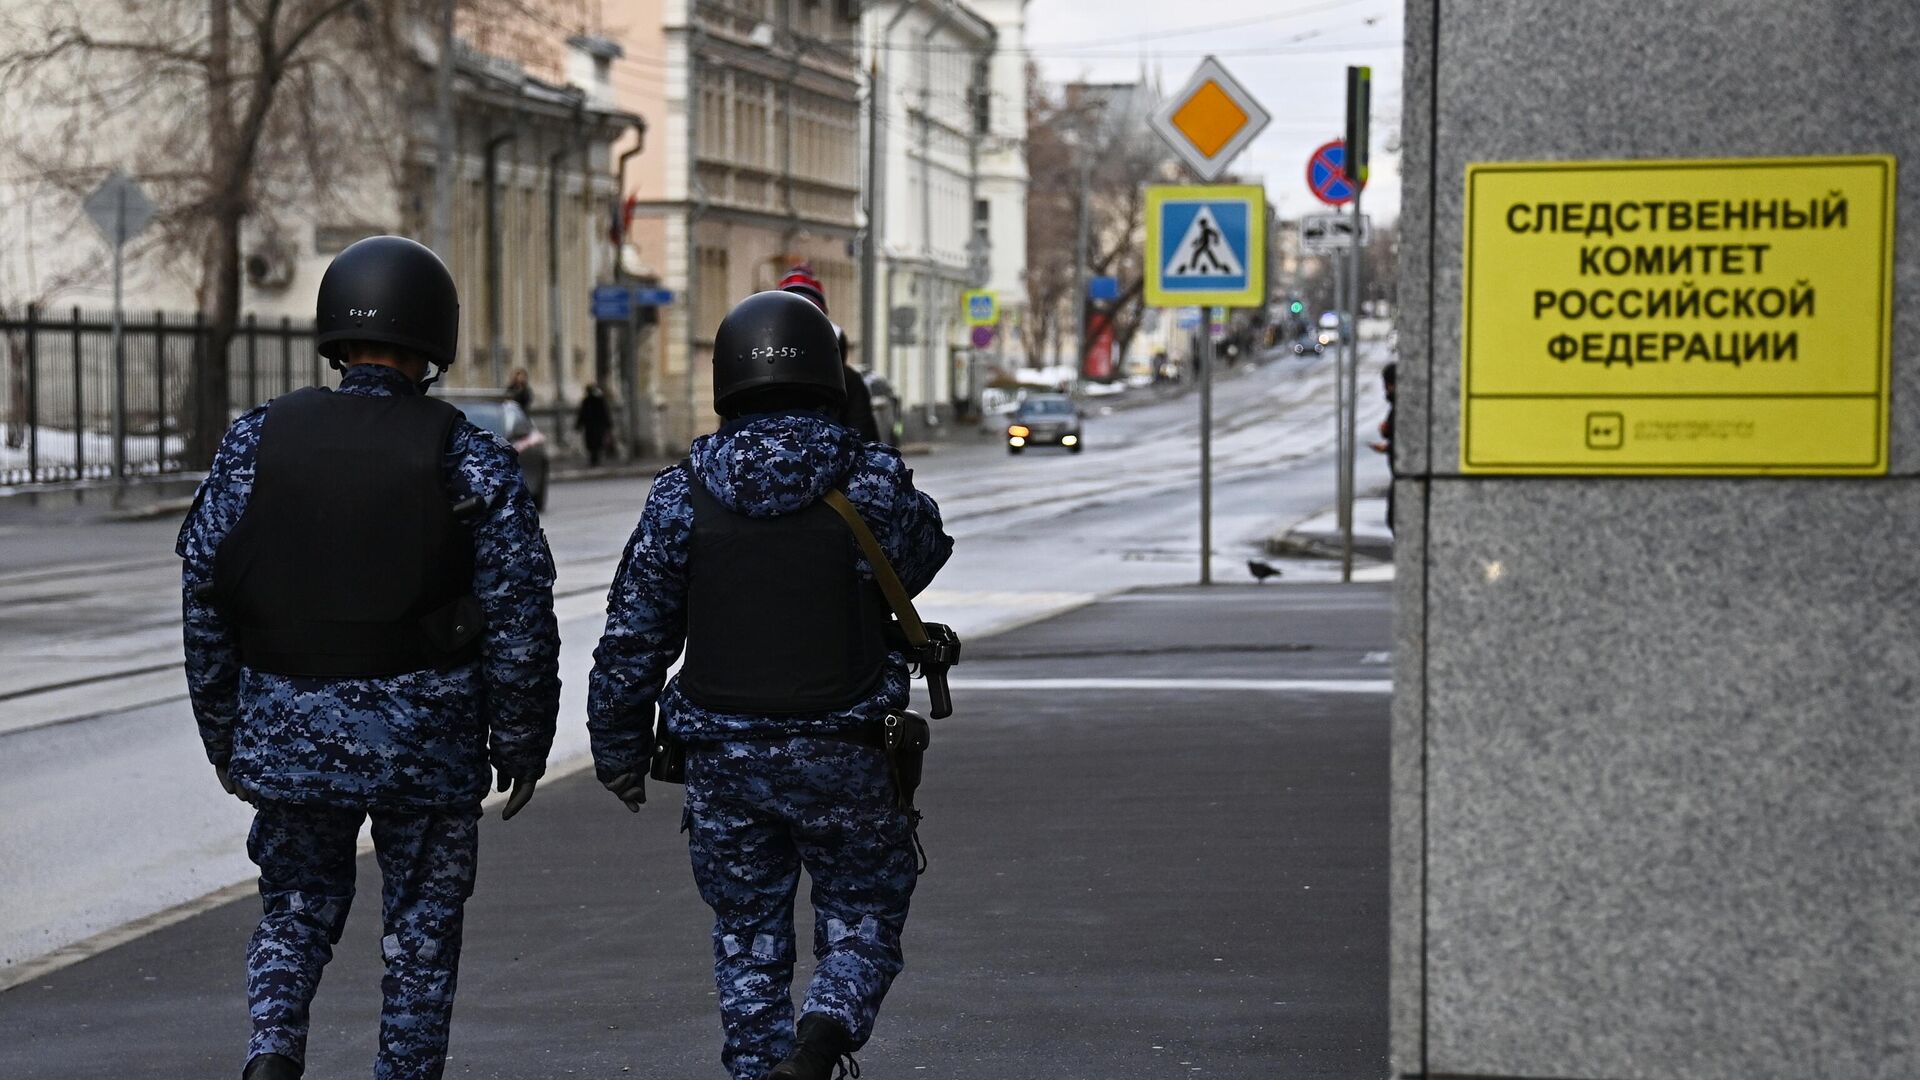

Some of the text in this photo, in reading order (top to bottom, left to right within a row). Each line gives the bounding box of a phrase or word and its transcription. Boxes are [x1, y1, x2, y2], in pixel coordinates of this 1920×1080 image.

[1506, 190, 1848, 237] СЛЕДСТВЕННЫЙ
[1579, 244, 1770, 276] КОМИТЕТ
[1533, 280, 1815, 320] РОССИЙСКОЙ
[751, 346, 798, 360] 5-2-55
[1547, 331, 1798, 368] ФЕДЕРАЦИИ
